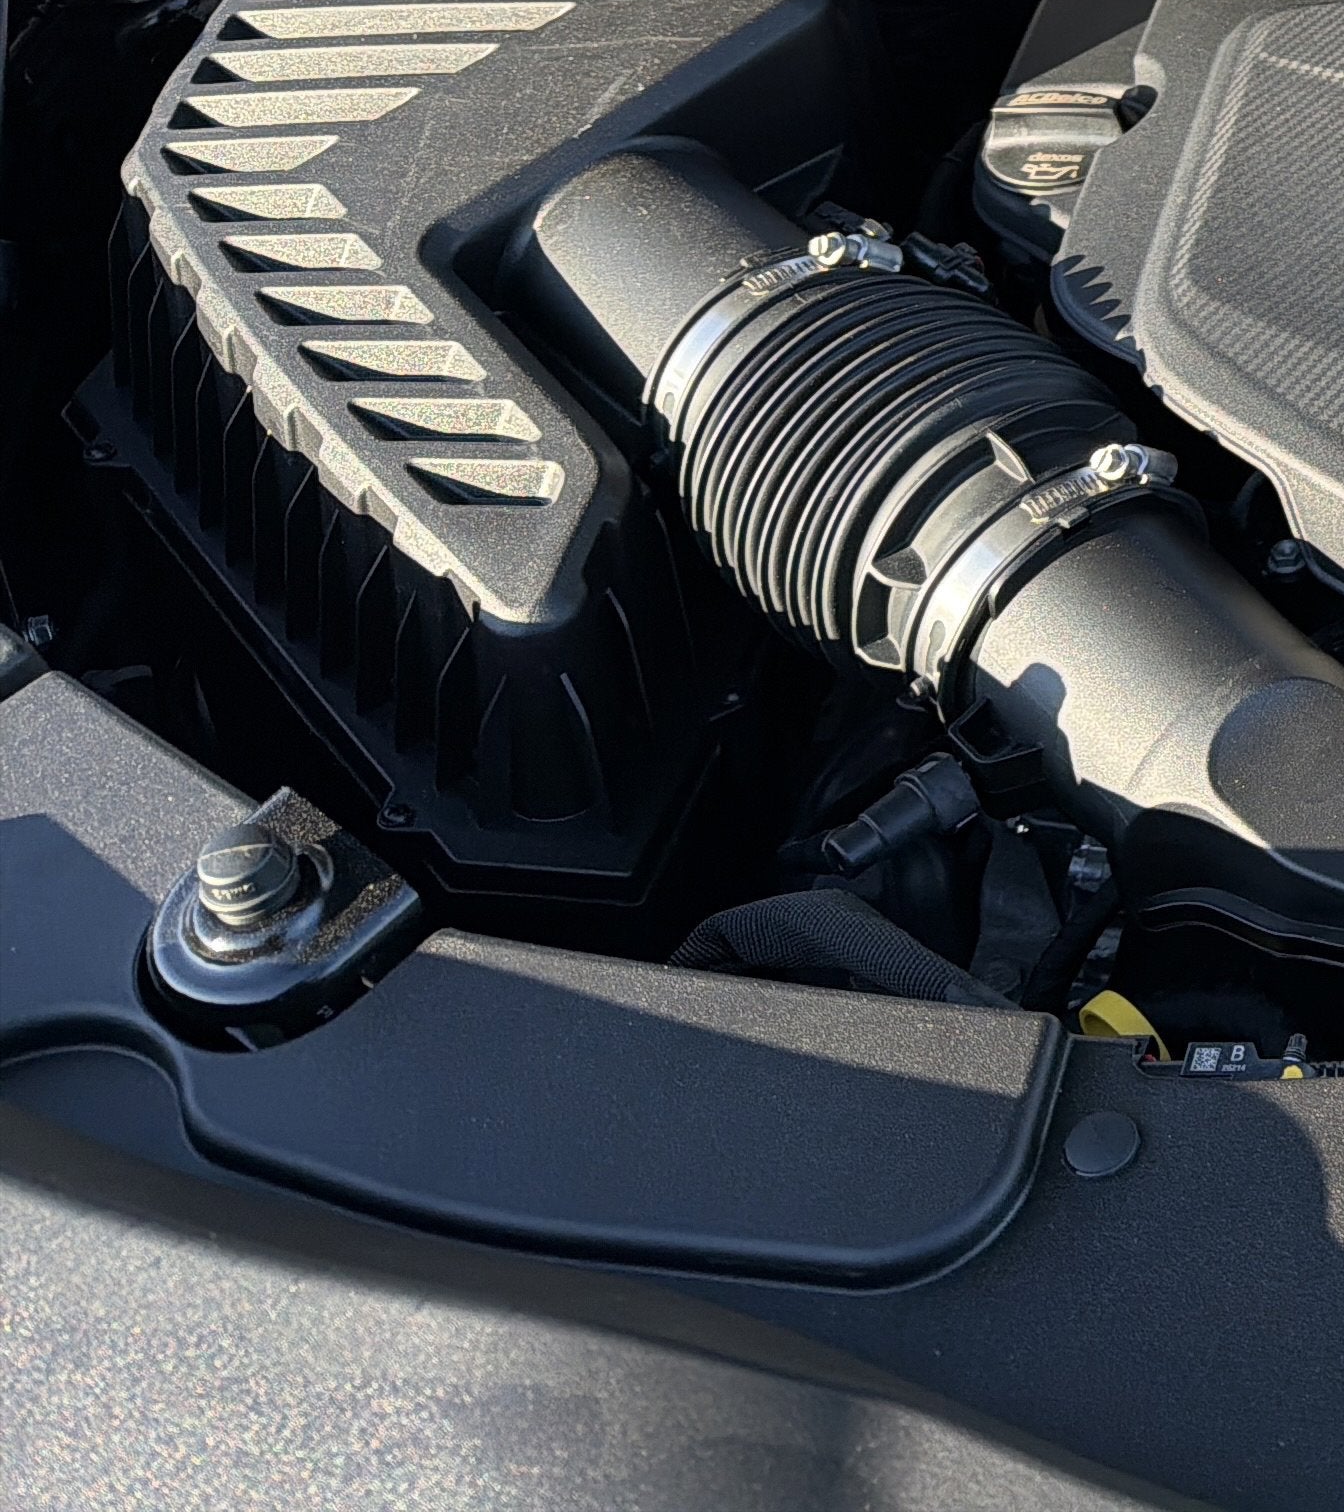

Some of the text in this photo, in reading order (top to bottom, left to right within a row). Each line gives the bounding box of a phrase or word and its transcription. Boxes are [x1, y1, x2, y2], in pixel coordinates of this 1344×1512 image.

[1007, 92, 1108, 106] ACDelco
[1027, 152, 1085, 162] dexos
[1231, 1044, 1245, 1062] B
